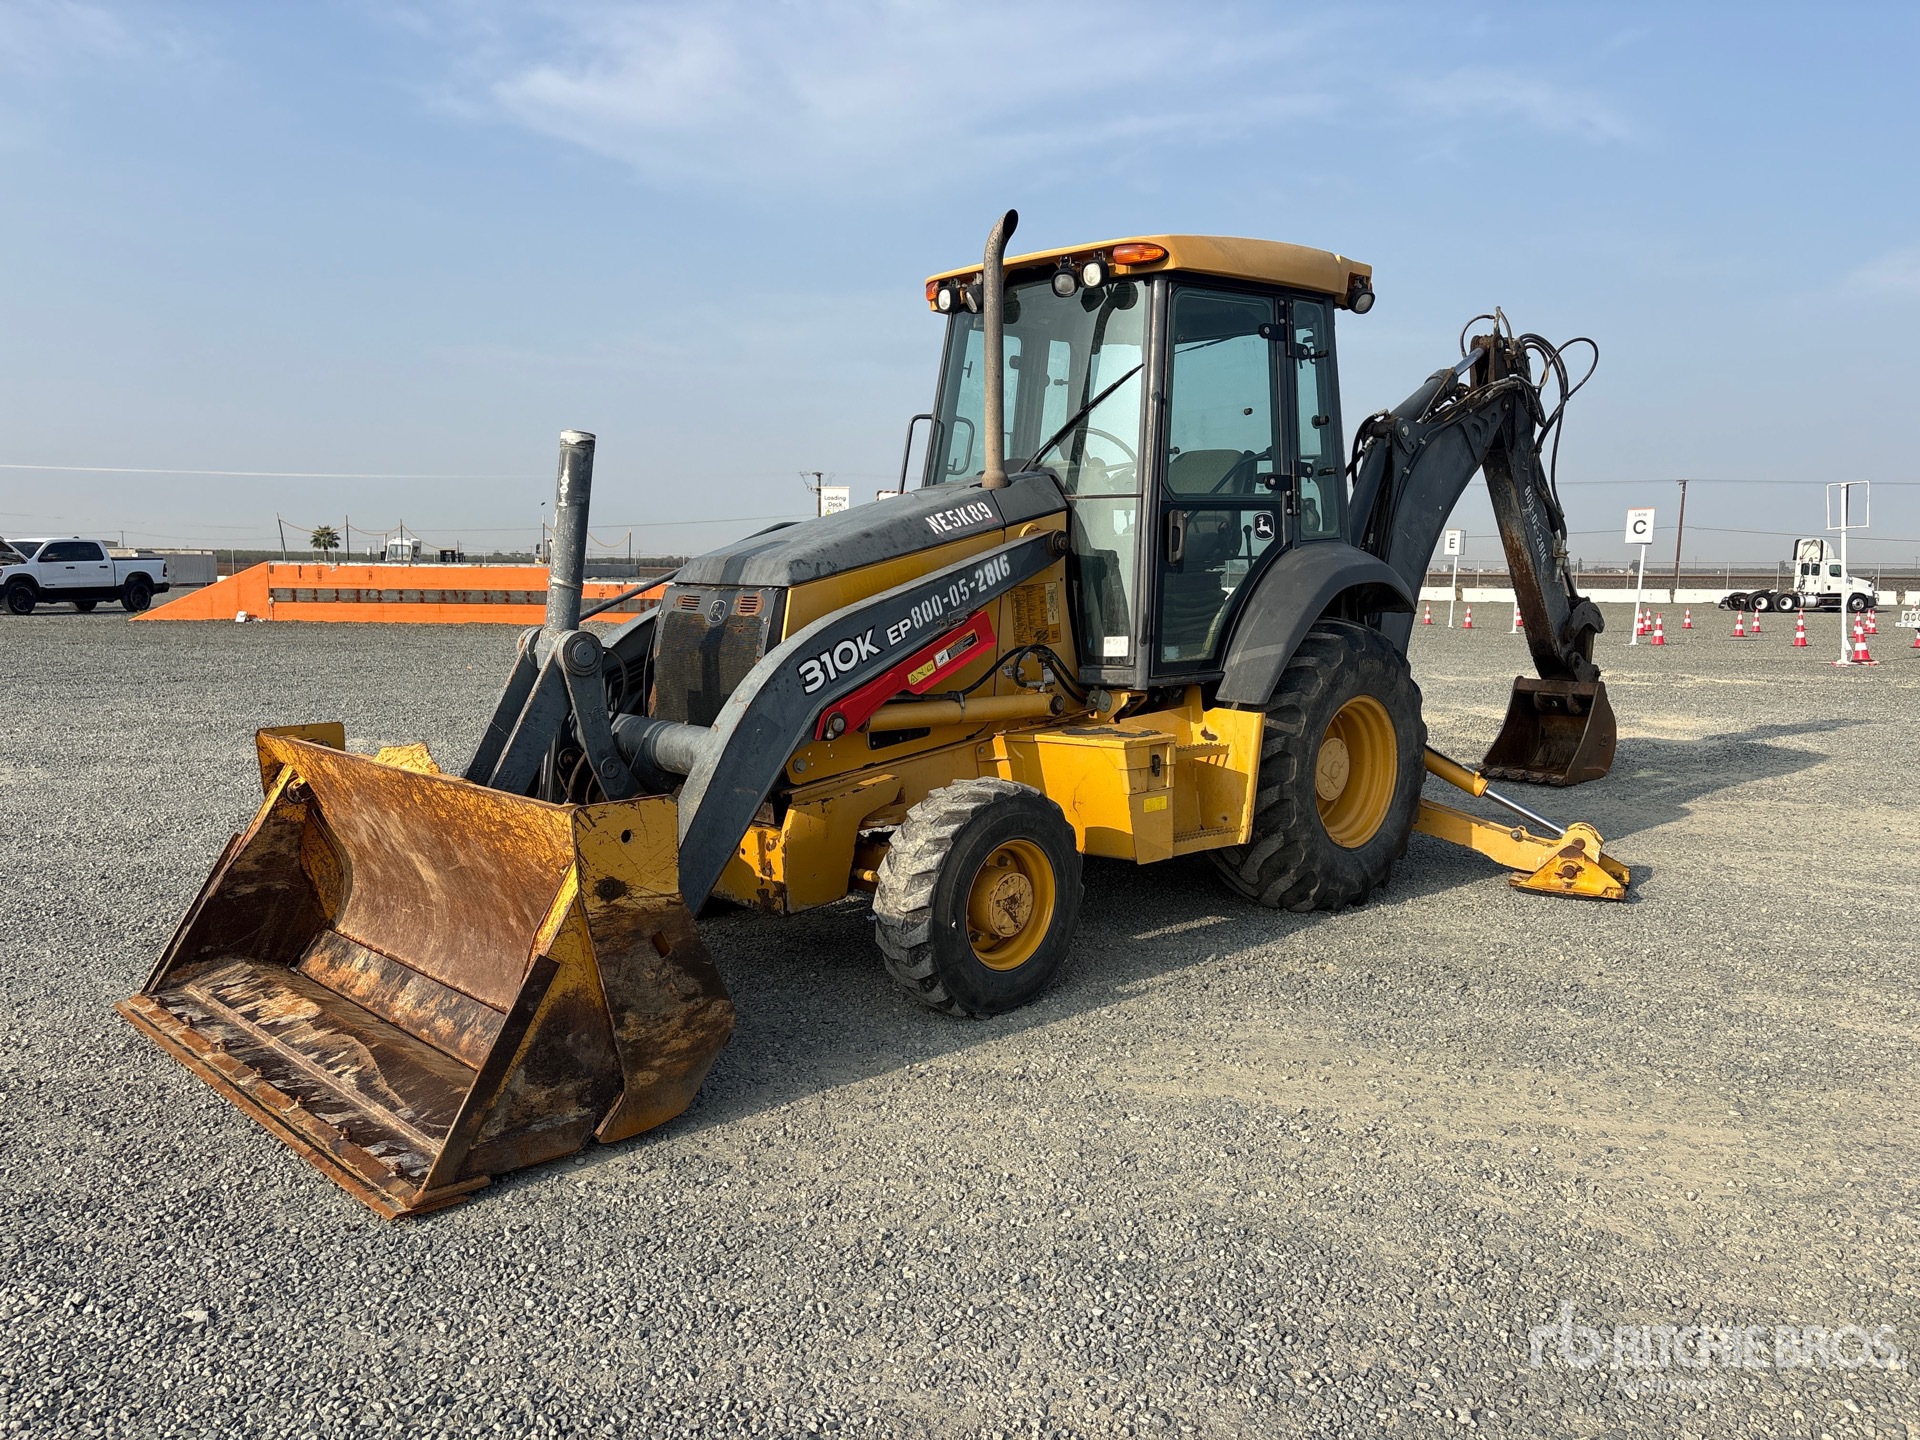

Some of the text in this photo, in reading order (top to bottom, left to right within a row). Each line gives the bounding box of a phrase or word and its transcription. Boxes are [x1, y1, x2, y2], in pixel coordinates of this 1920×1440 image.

[925, 502, 992, 534] NE5K89
[1633, 519, 1647, 535] C
[1449, 538, 1456, 548] E
[798, 628, 881, 694] 310K
[887, 618, 912, 645] EP
